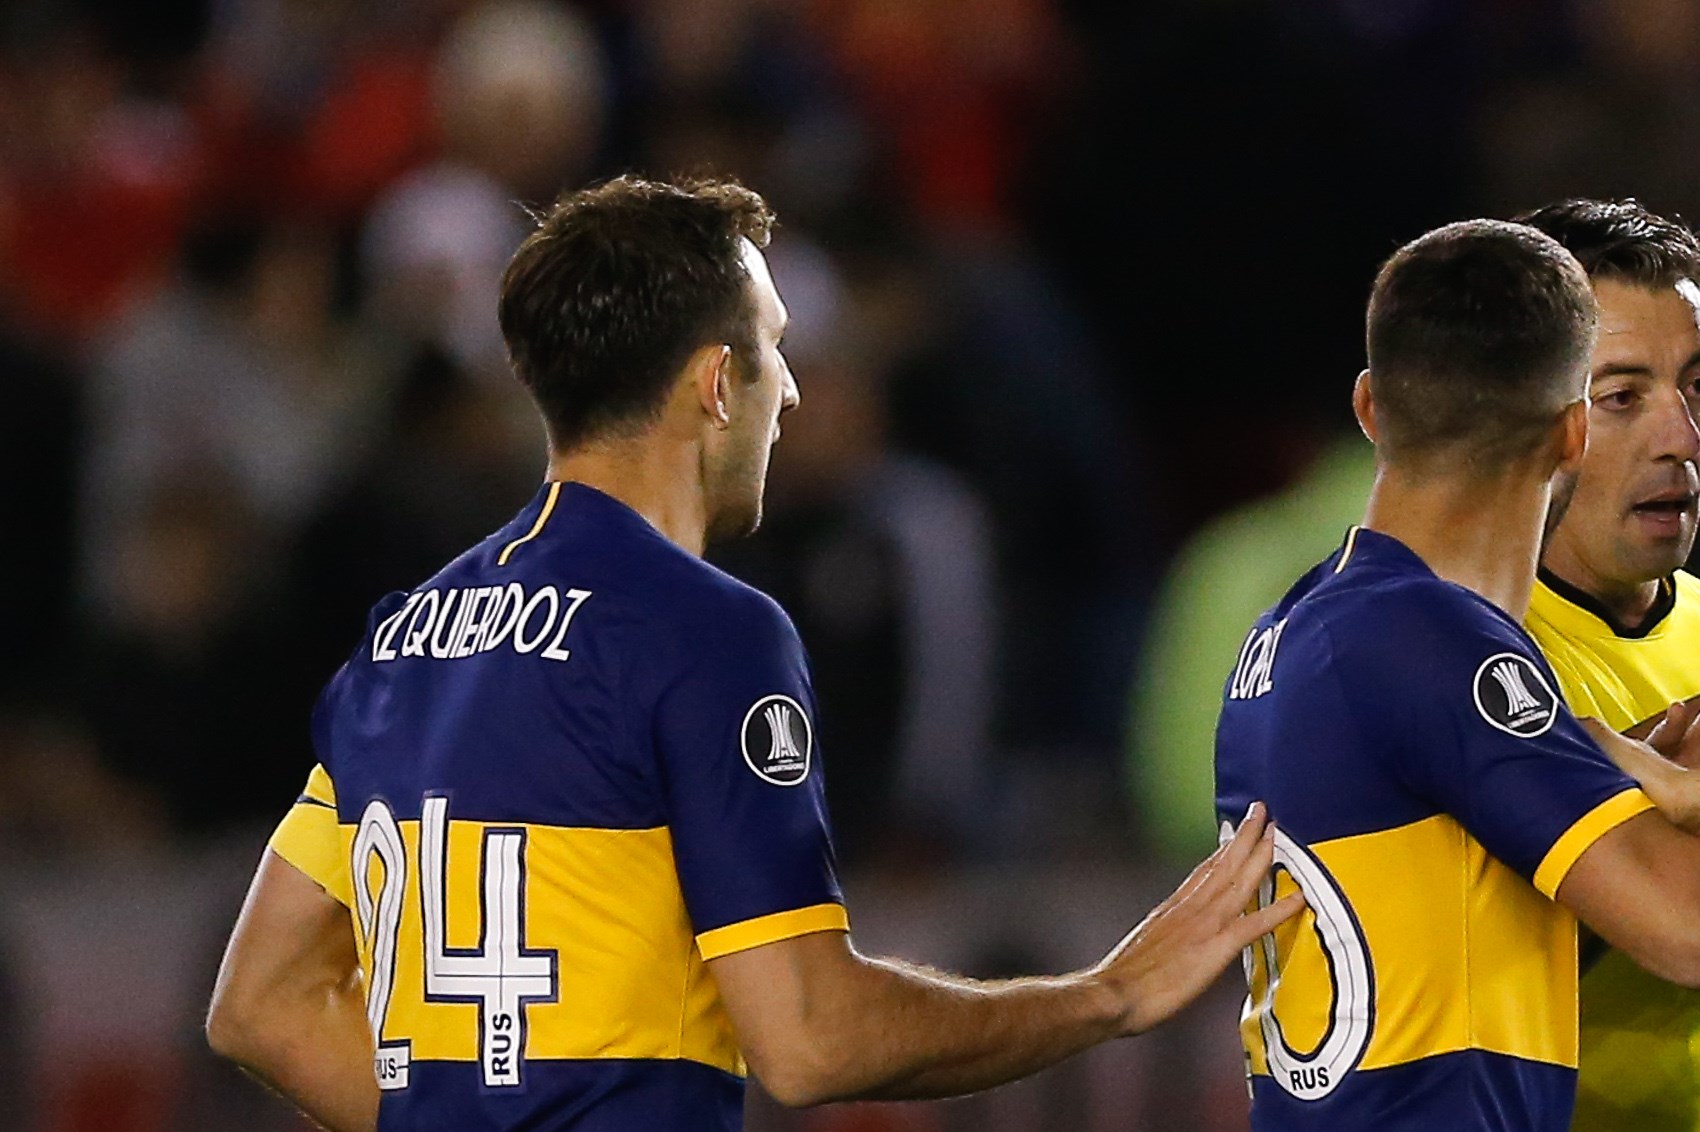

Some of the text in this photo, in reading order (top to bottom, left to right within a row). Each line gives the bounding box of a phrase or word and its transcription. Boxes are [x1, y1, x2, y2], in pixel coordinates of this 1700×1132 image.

[350, 796, 555, 1088] 24
[491, 1013, 512, 1075] RUS
[1290, 1067, 1330, 1090] RUS
